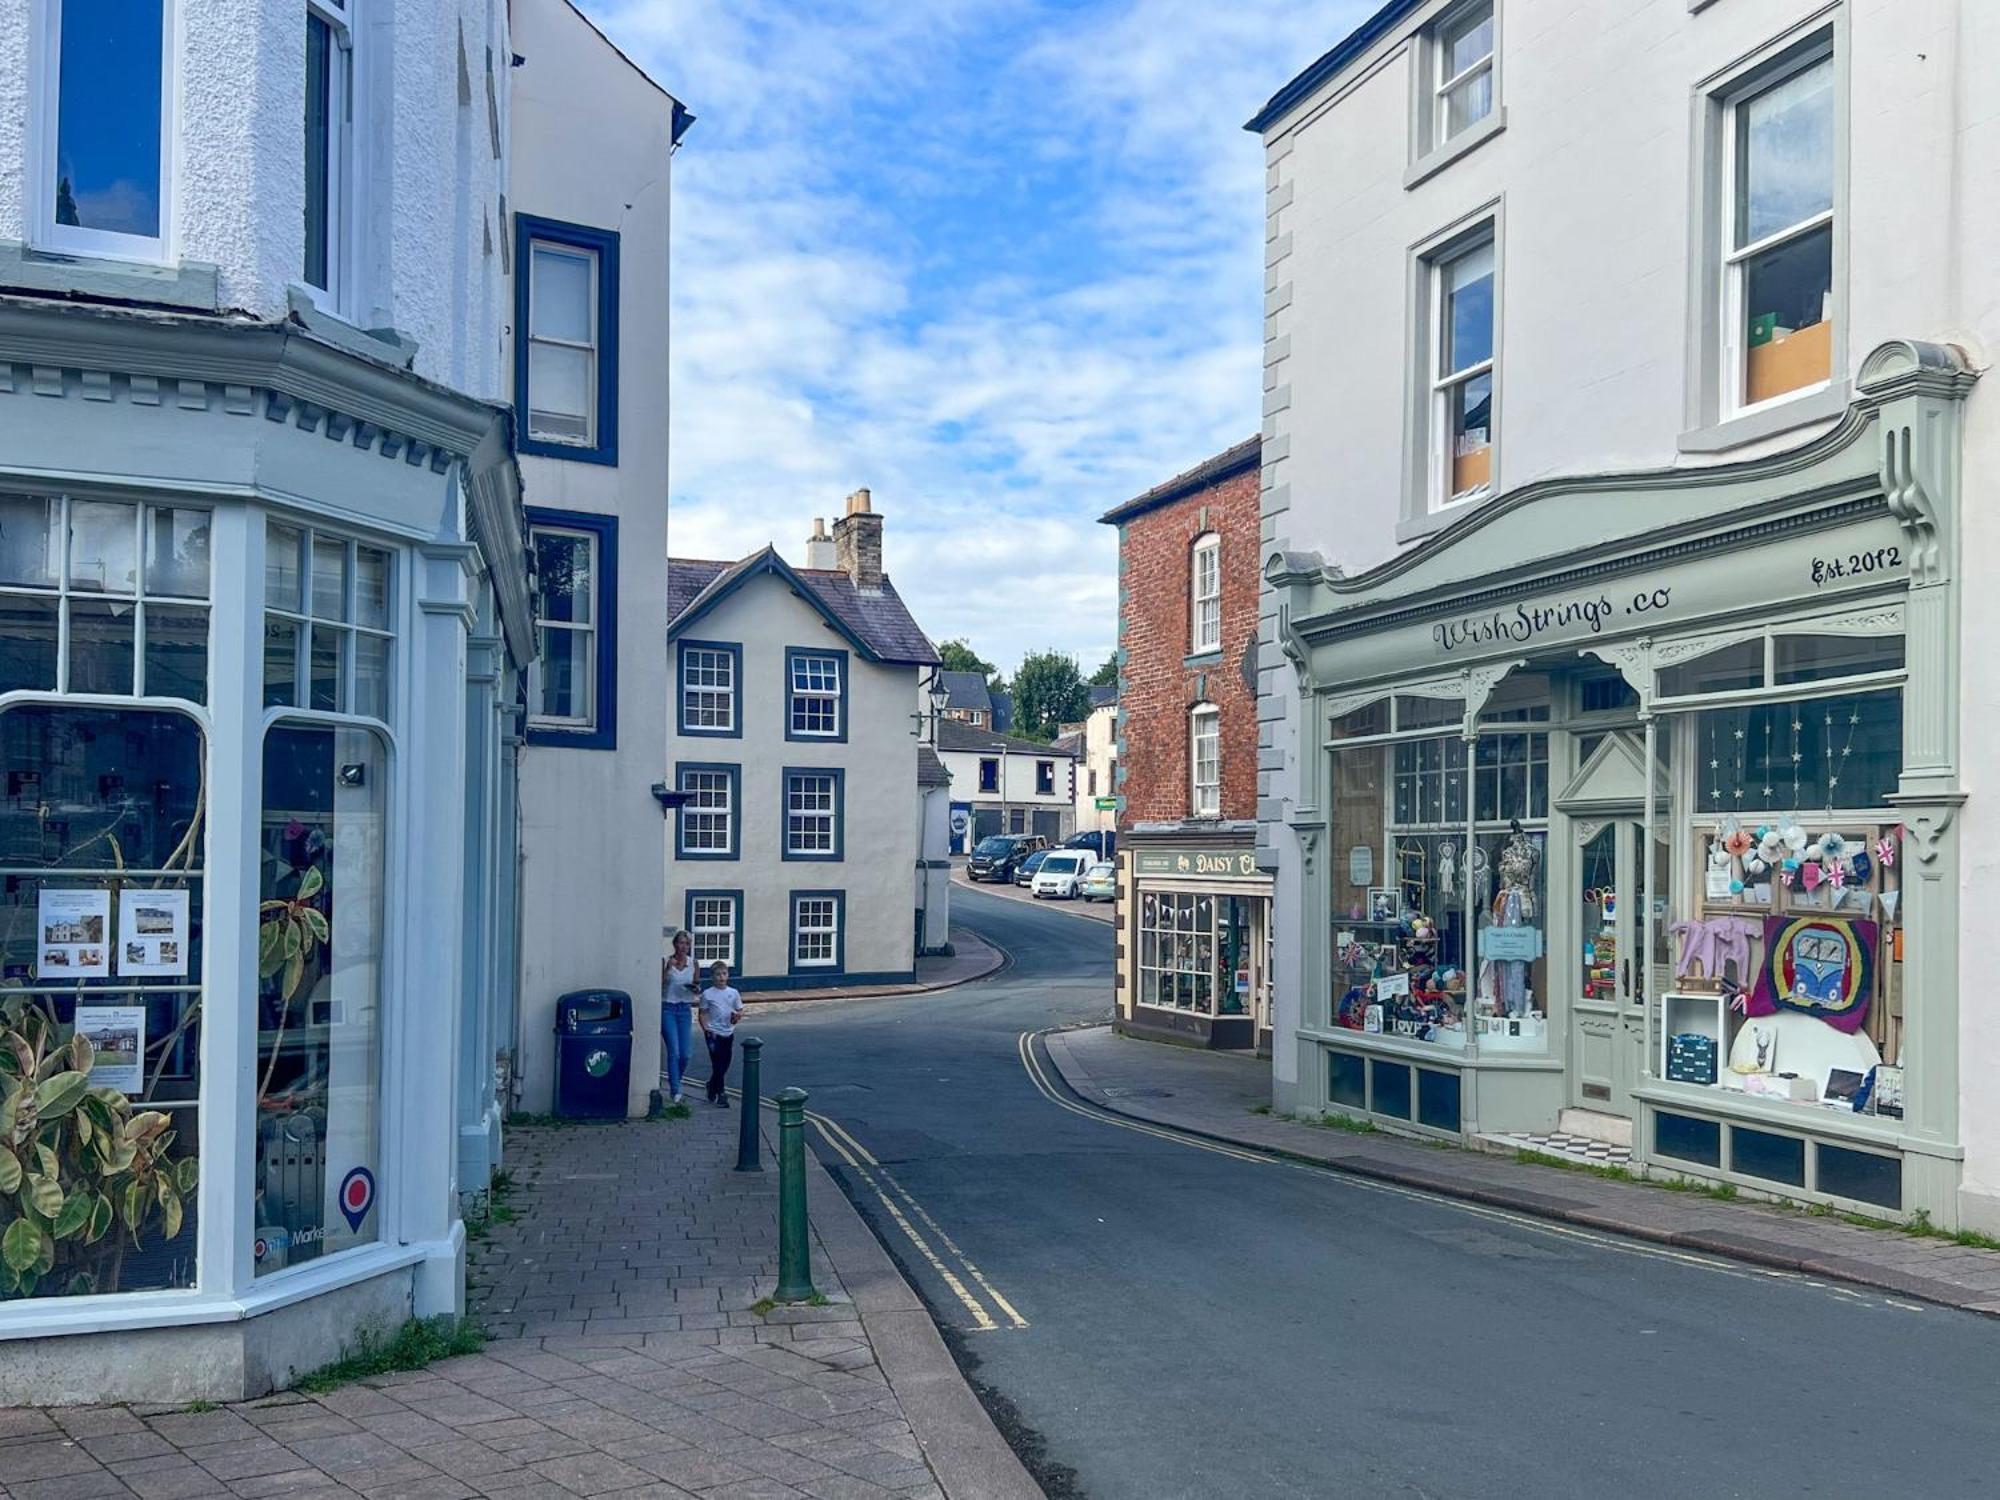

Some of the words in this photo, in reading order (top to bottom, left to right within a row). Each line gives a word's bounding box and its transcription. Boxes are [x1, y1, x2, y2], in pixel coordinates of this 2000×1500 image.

[1811, 546, 1903, 588] Est.2012
[1432, 595, 1612, 651] WishStrings
[1196, 854, 1234, 873] DAISY
